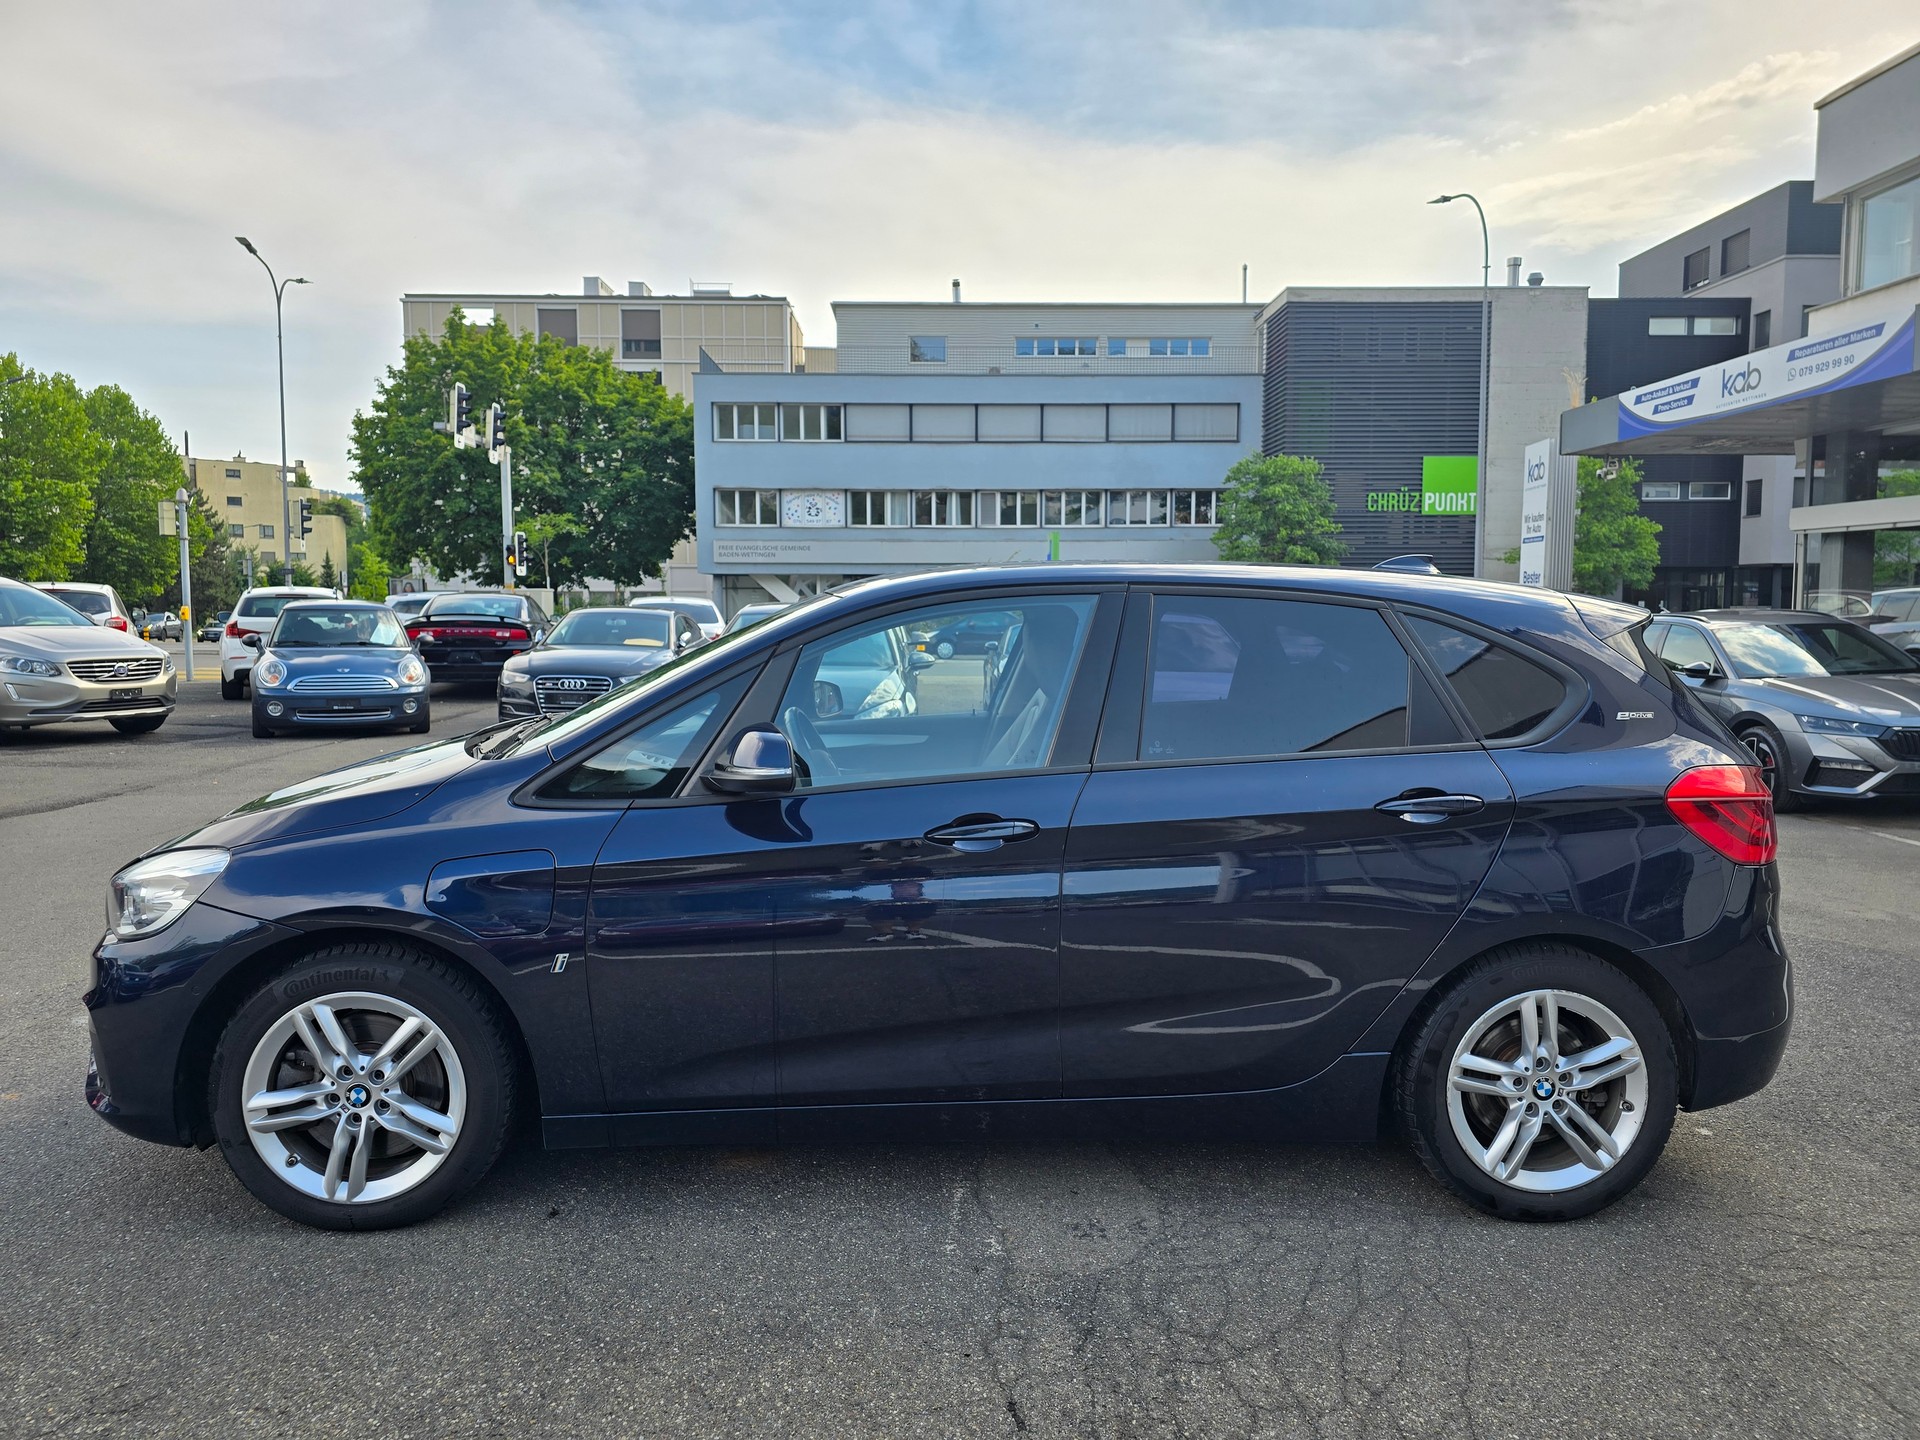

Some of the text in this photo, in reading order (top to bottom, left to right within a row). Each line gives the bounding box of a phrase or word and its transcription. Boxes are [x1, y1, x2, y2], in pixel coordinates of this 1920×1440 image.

[1794, 328, 1876, 359] Reparaturen aller Marken
[1799, 354, 1855, 377] 079 929 99 90
[1640, 388, 1668, 403] Auto-Ankauf
[1673, 380, 1692, 394] Verkauf
[1721, 361, 1762, 398] kab
[1657, 398, 1688, 413] Pneu-Service
[1527, 455, 1545, 484] kab
[1367, 486, 1477, 513] CHRÜZ PUNKT
[1522, 570, 1541, 584] Bester
[282, 967, 378, 997] Continental
